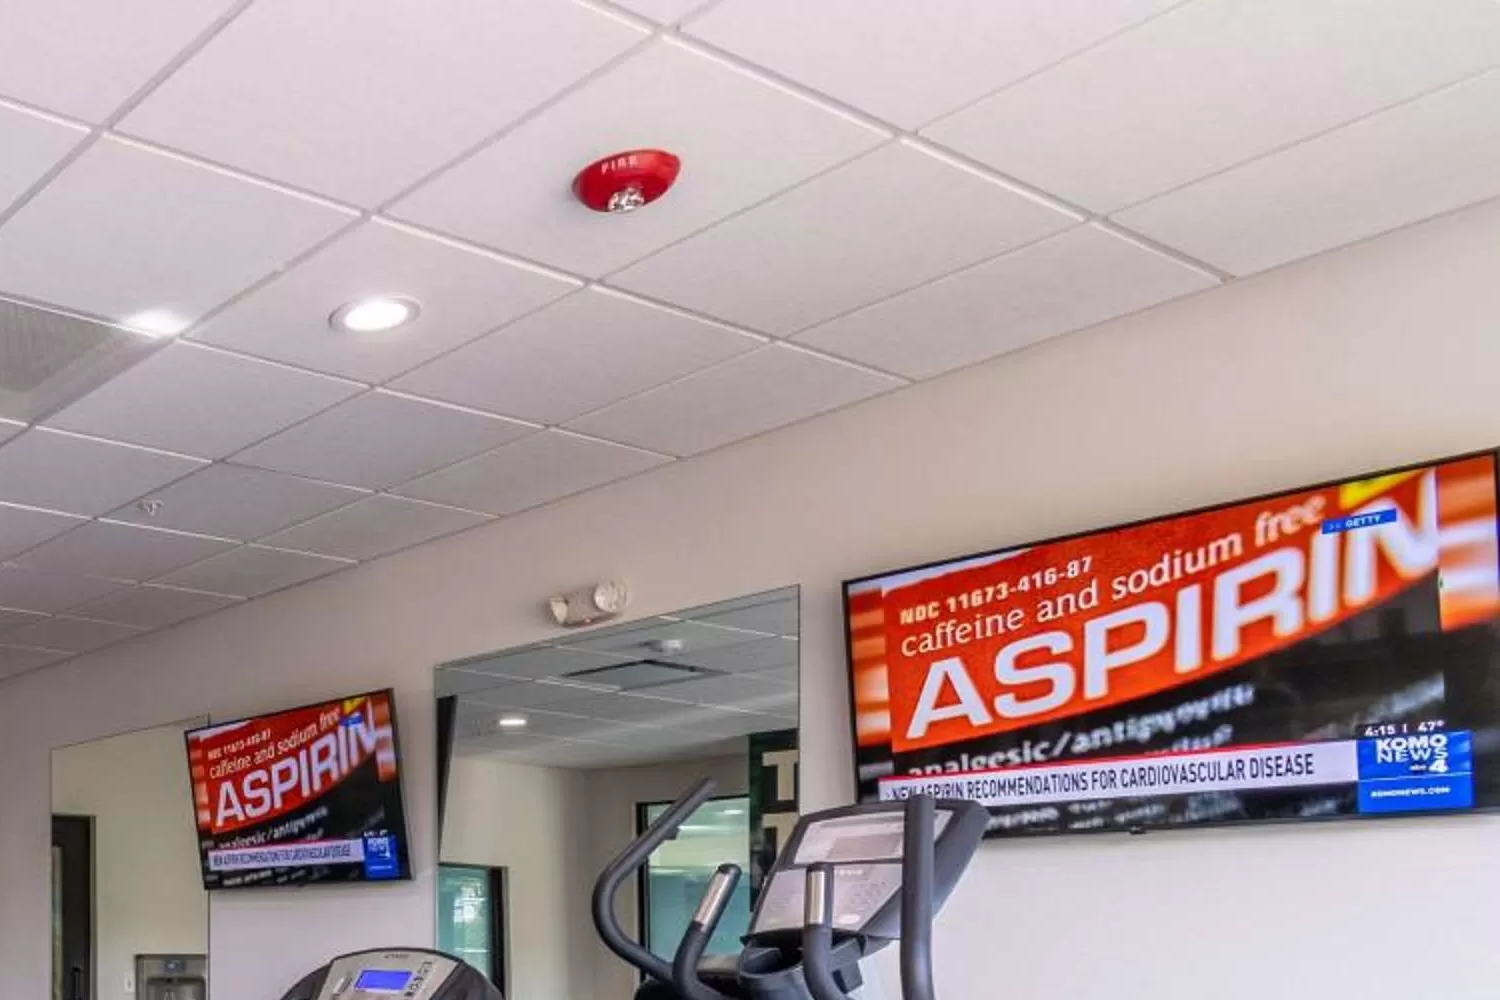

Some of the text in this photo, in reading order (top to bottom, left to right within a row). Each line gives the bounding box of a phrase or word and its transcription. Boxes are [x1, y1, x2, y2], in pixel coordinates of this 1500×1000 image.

[1345, 514, 1381, 528] GETTY
[901, 495, 1327, 656] caffeine and sodium free
[901, 555, 1093, 624] NDC 11673-416-87
[906, 467, 1439, 739] ASPIRIN
[1364, 724, 1396, 737] 4:15
[1376, 733, 1448, 752] KOMO
[209, 753, 252, 779] caffeine
[216, 696, 378, 827] ASPIRIN
[1376, 747, 1449, 764] NEWS
[1428, 759, 1449, 773] 4
[967, 771, 1088, 798] RECOMMENDATIONS
[1091, 769, 1117, 790] FOR
[1120, 758, 1248, 788] CARDIOVASCULAR
[1250, 753, 1315, 779] DISEASE
